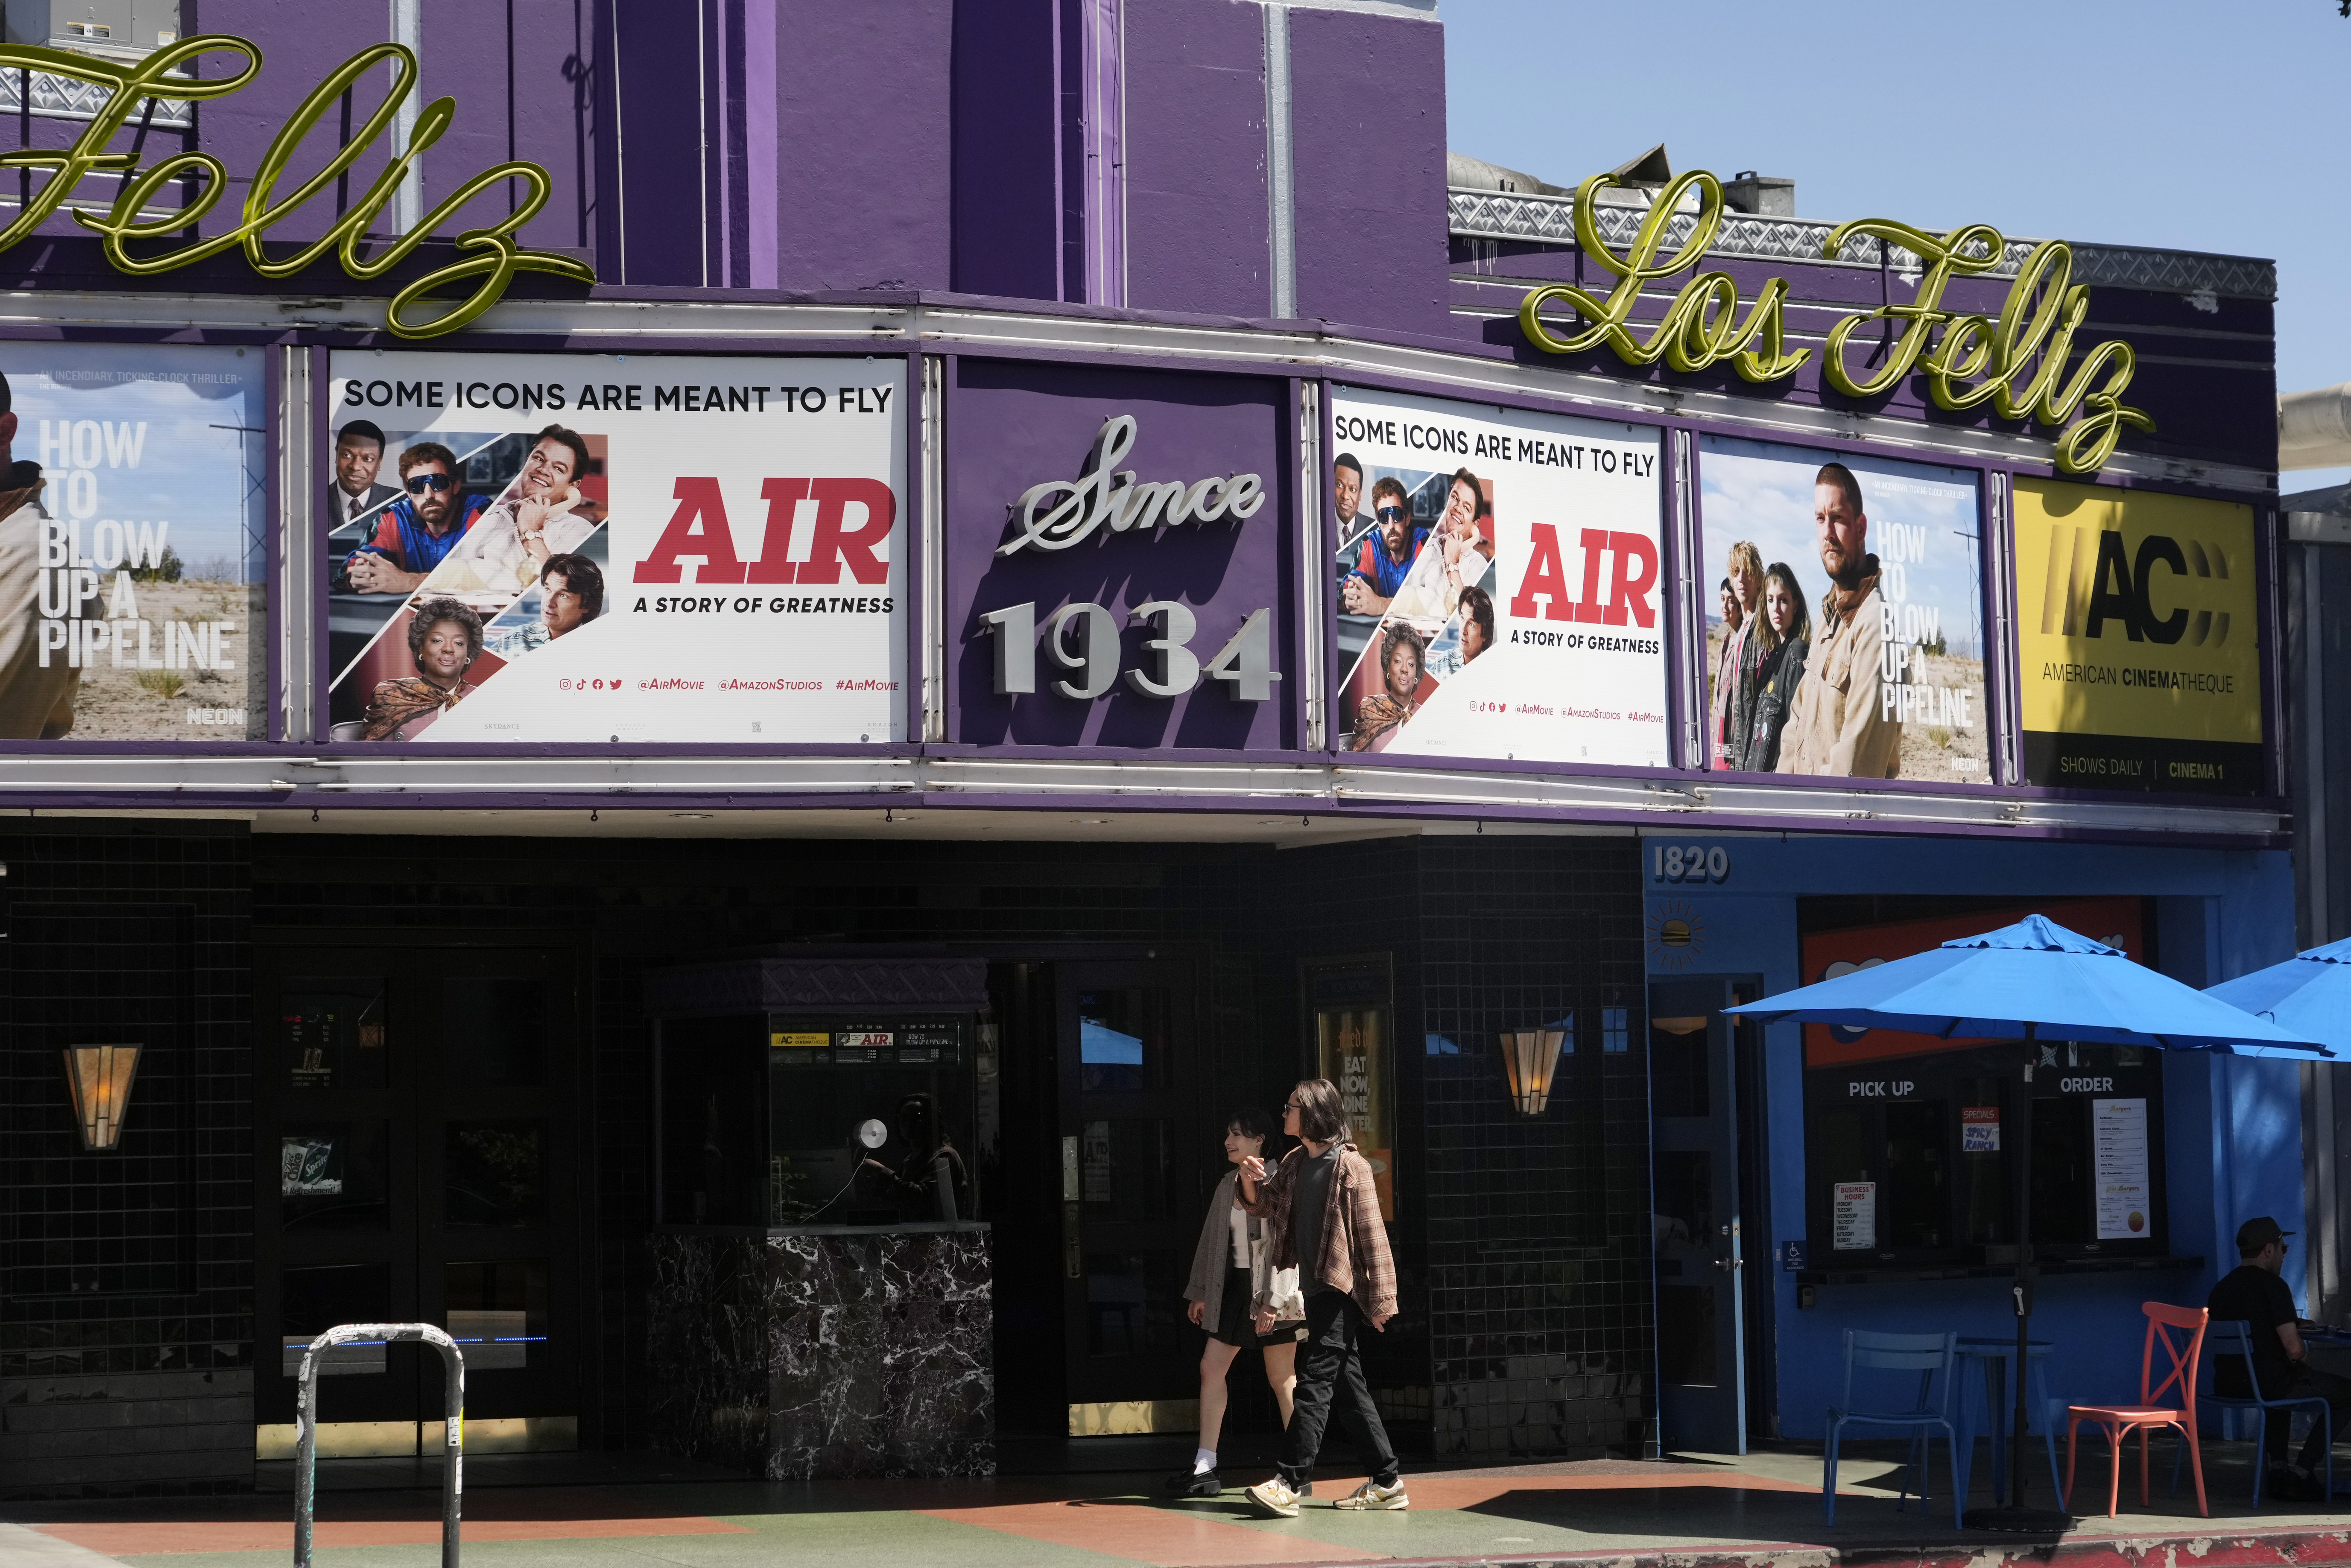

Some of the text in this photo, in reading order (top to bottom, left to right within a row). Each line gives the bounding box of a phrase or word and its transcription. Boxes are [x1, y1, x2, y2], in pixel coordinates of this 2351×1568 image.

[1520, 169, 2156, 474] Los Feliz
[56, 371, 114, 382] INCENDIARY,
[117, 372, 189, 383] TICKING-CLOCK
[345, 380, 892, 413] SOME ICONS ARE MEANT TO FLY
[39, 420, 147, 469] HOW
[1335, 415, 1655, 478] SOME ICONS ARE MEANT TO FLY
[39, 470, 97, 519] TO
[995, 415, 1265, 557] Since
[1881, 482, 1909, 493] INCENDIARY,
[1909, 485, 1942, 497] TICKING-CLOCK
[39, 520, 168, 569] BLOW
[633, 477, 896, 584] AIR
[1877, 520, 1925, 564] HOW
[1510, 522, 1659, 629] AIR
[1878, 562, 1906, 603] TO
[39, 570, 138, 619] UP A
[633, 598, 894, 613] A STORY OF GREATNESS
[1880, 602, 1939, 645] BLOW
[39, 619, 235, 670] PIPELINE
[978, 601, 1283, 702] 1934
[1511, 629, 1659, 655] A STORY OF GREATNESS
[1881, 642, 1927, 685] UP A
[2043, 662, 2234, 694] AMERICAN CINEMATHEQUE
[187, 708, 243, 725] NEON
[1882, 683, 1973, 728] PIPELINE
[1952, 757, 1979, 772] NEON
[2061, 756, 2143, 776] SHOWS DAILY
[2169, 762, 2223, 779] CINEMA 1
[1655, 846, 1729, 883] 1820
[860, 1034, 889, 1045] AIR
[1344, 1056, 1366, 1074] EAT
[1340, 1076, 1371, 1096] NOW,
[1849, 1081, 1915, 1097] PICK UP
[2061, 1077, 2114, 1092] ORDER
[1344, 1095, 1368, 1112] DINE
[1964, 1110, 1995, 1119] SPECIALS
[1964, 1139, 1995, 1151] RANCH
[1965, 1127, 1993, 1140] SPICY
[287, 1153, 303, 1181] Coke
[306, 1155, 328, 1177] Sprite
[290, 1186, 336, 1194] Refreshment!
